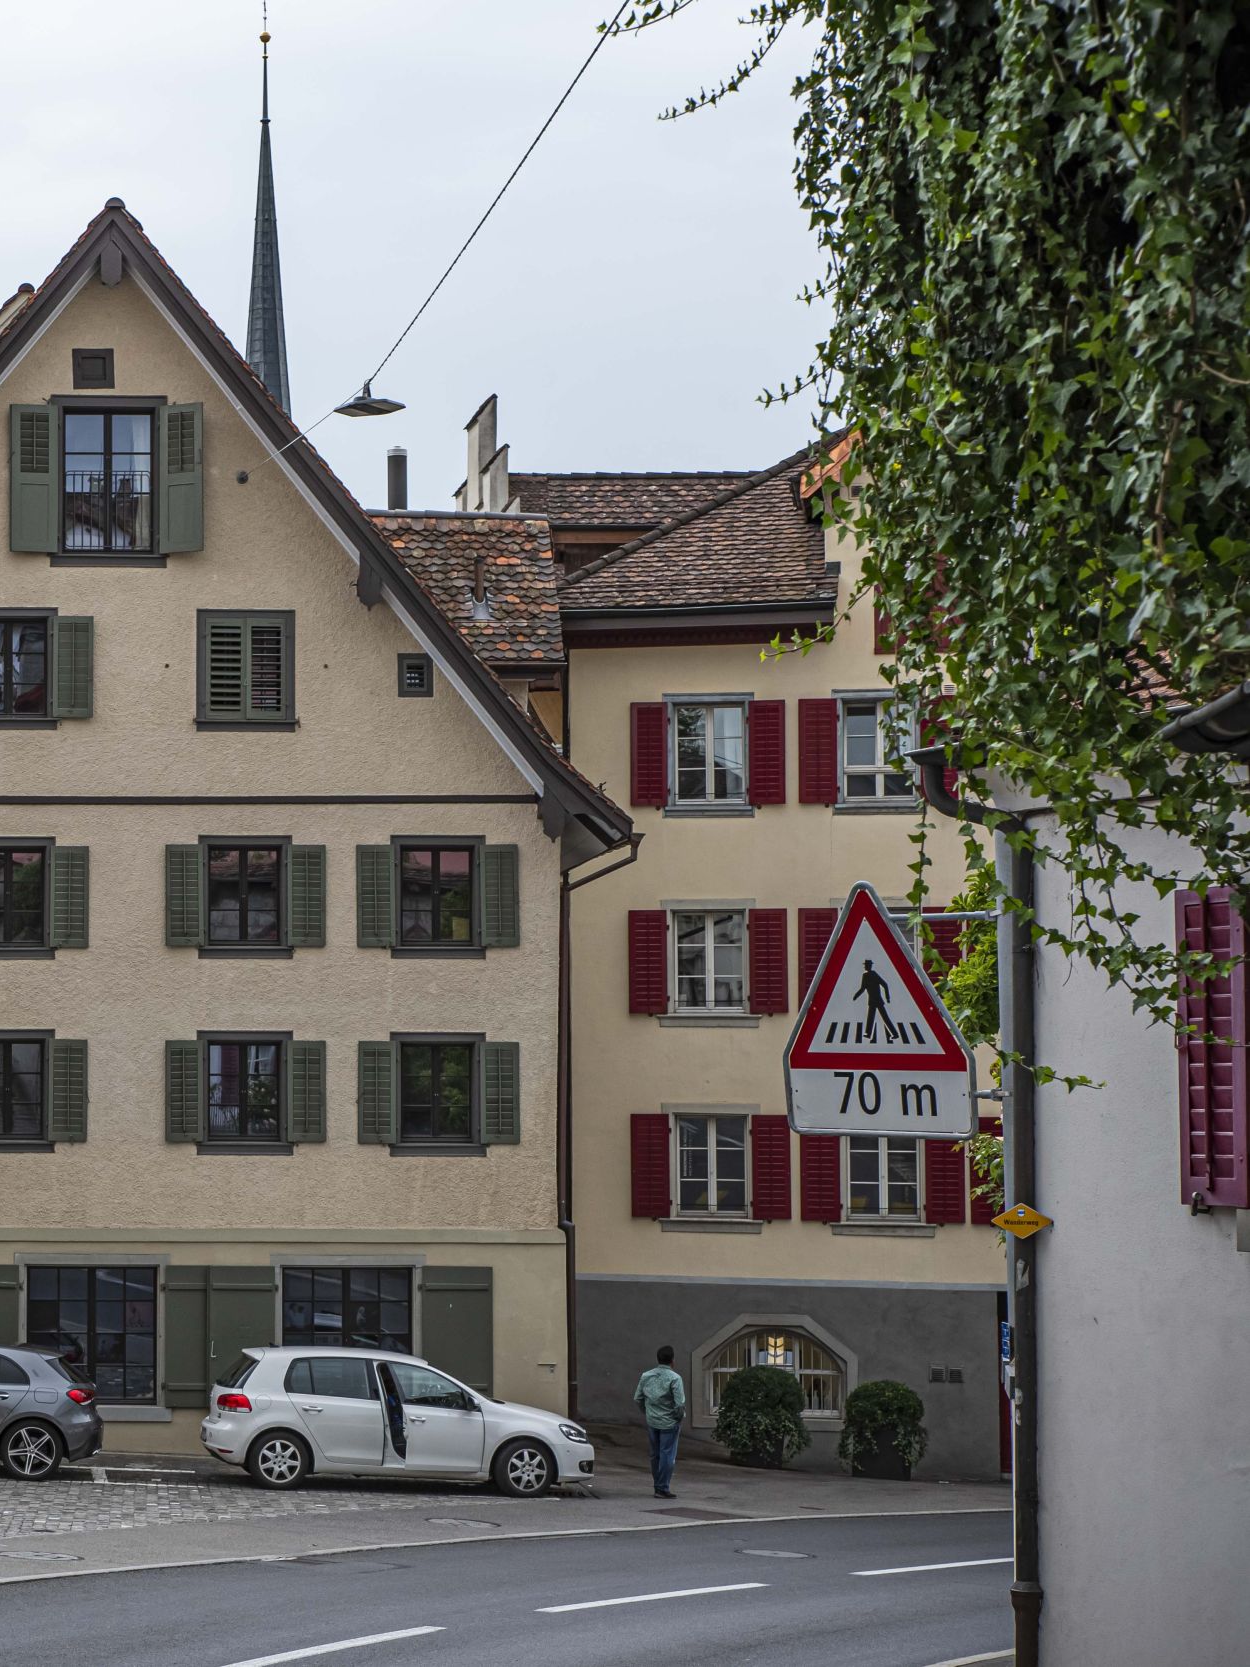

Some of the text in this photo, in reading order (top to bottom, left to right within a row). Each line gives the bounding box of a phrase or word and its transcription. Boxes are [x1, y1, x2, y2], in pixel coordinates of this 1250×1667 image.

[833, 1071, 938, 1117] 70 m
[1003, 1218, 1039, 1227] Wanderweg
